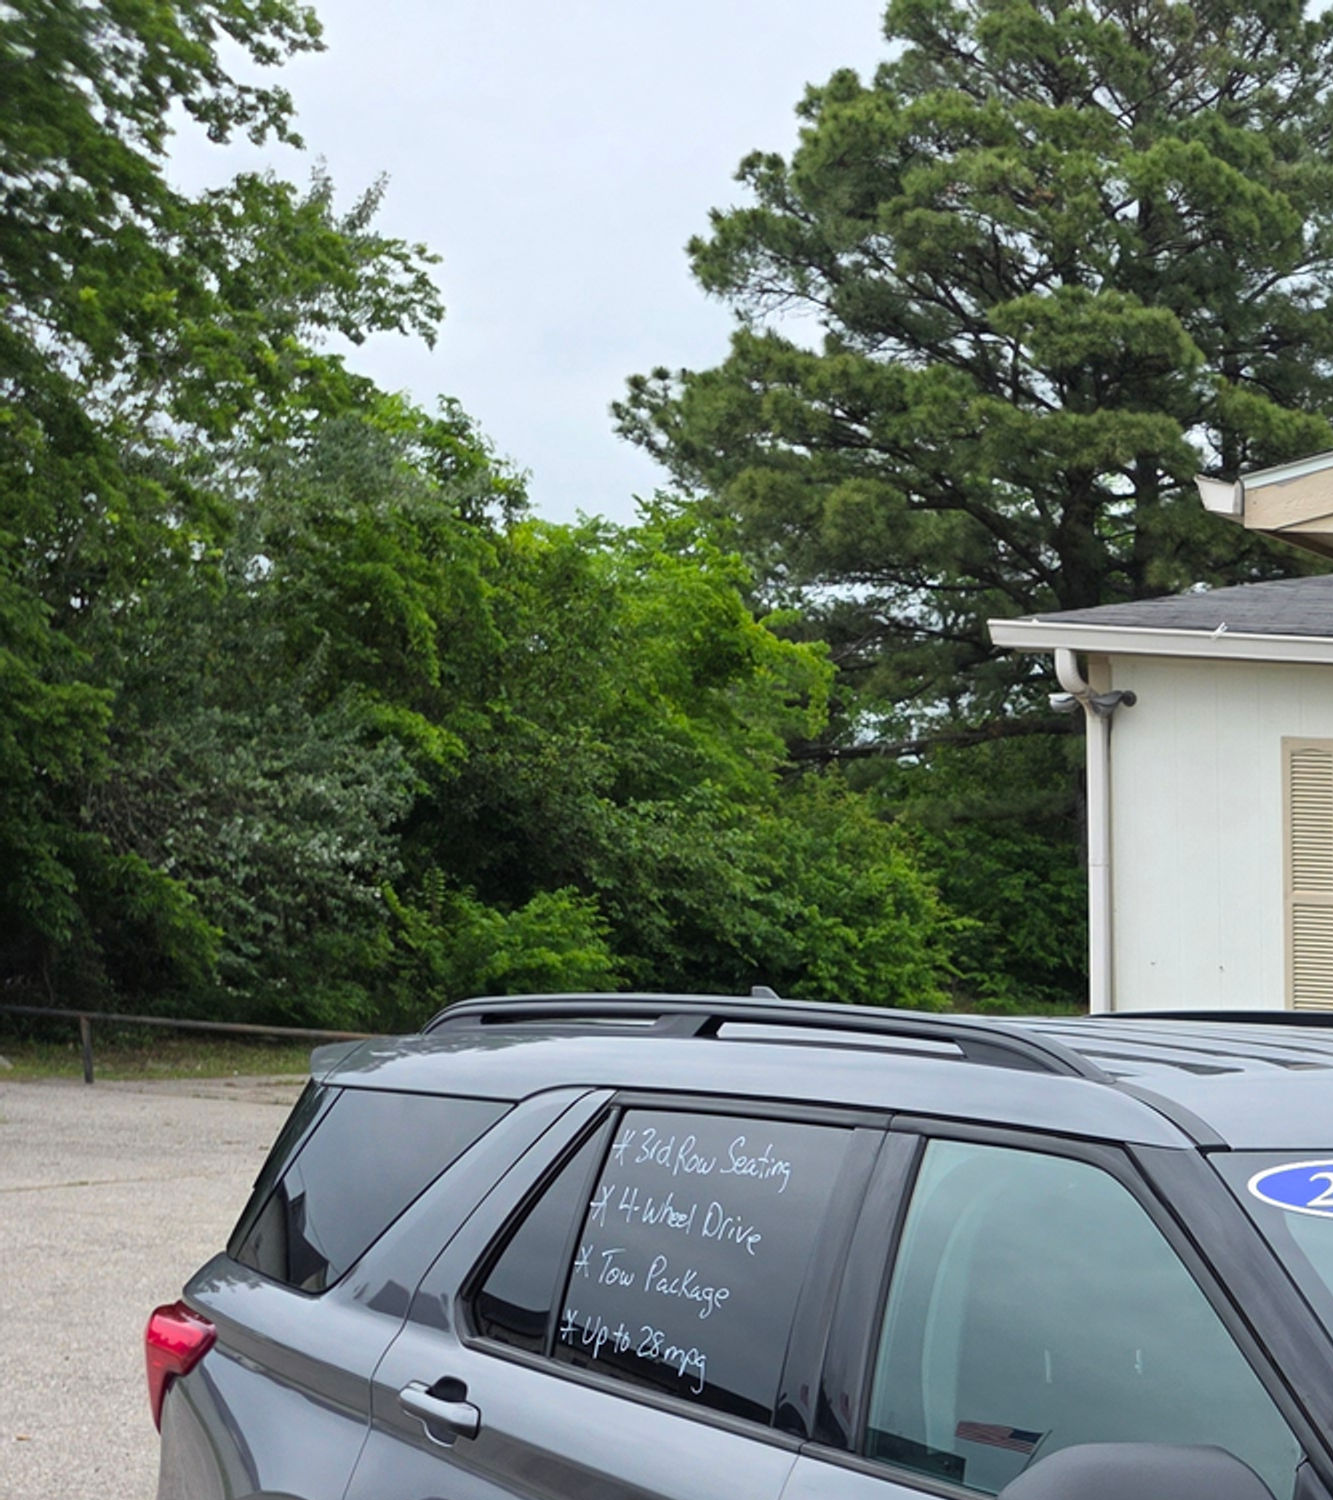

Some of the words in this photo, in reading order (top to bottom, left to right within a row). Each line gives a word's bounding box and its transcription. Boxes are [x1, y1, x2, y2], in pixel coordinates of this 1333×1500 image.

[636, 1127, 672, 1167] 3rd
[672, 1136, 716, 1176] Row
[720, 1135, 791, 1193] Seating
[702, 1202, 762, 1255] Drive
[599, 1247, 635, 1286] Tow
[582, 1315, 608, 1359] Up
[613, 1323, 631, 1353] to
